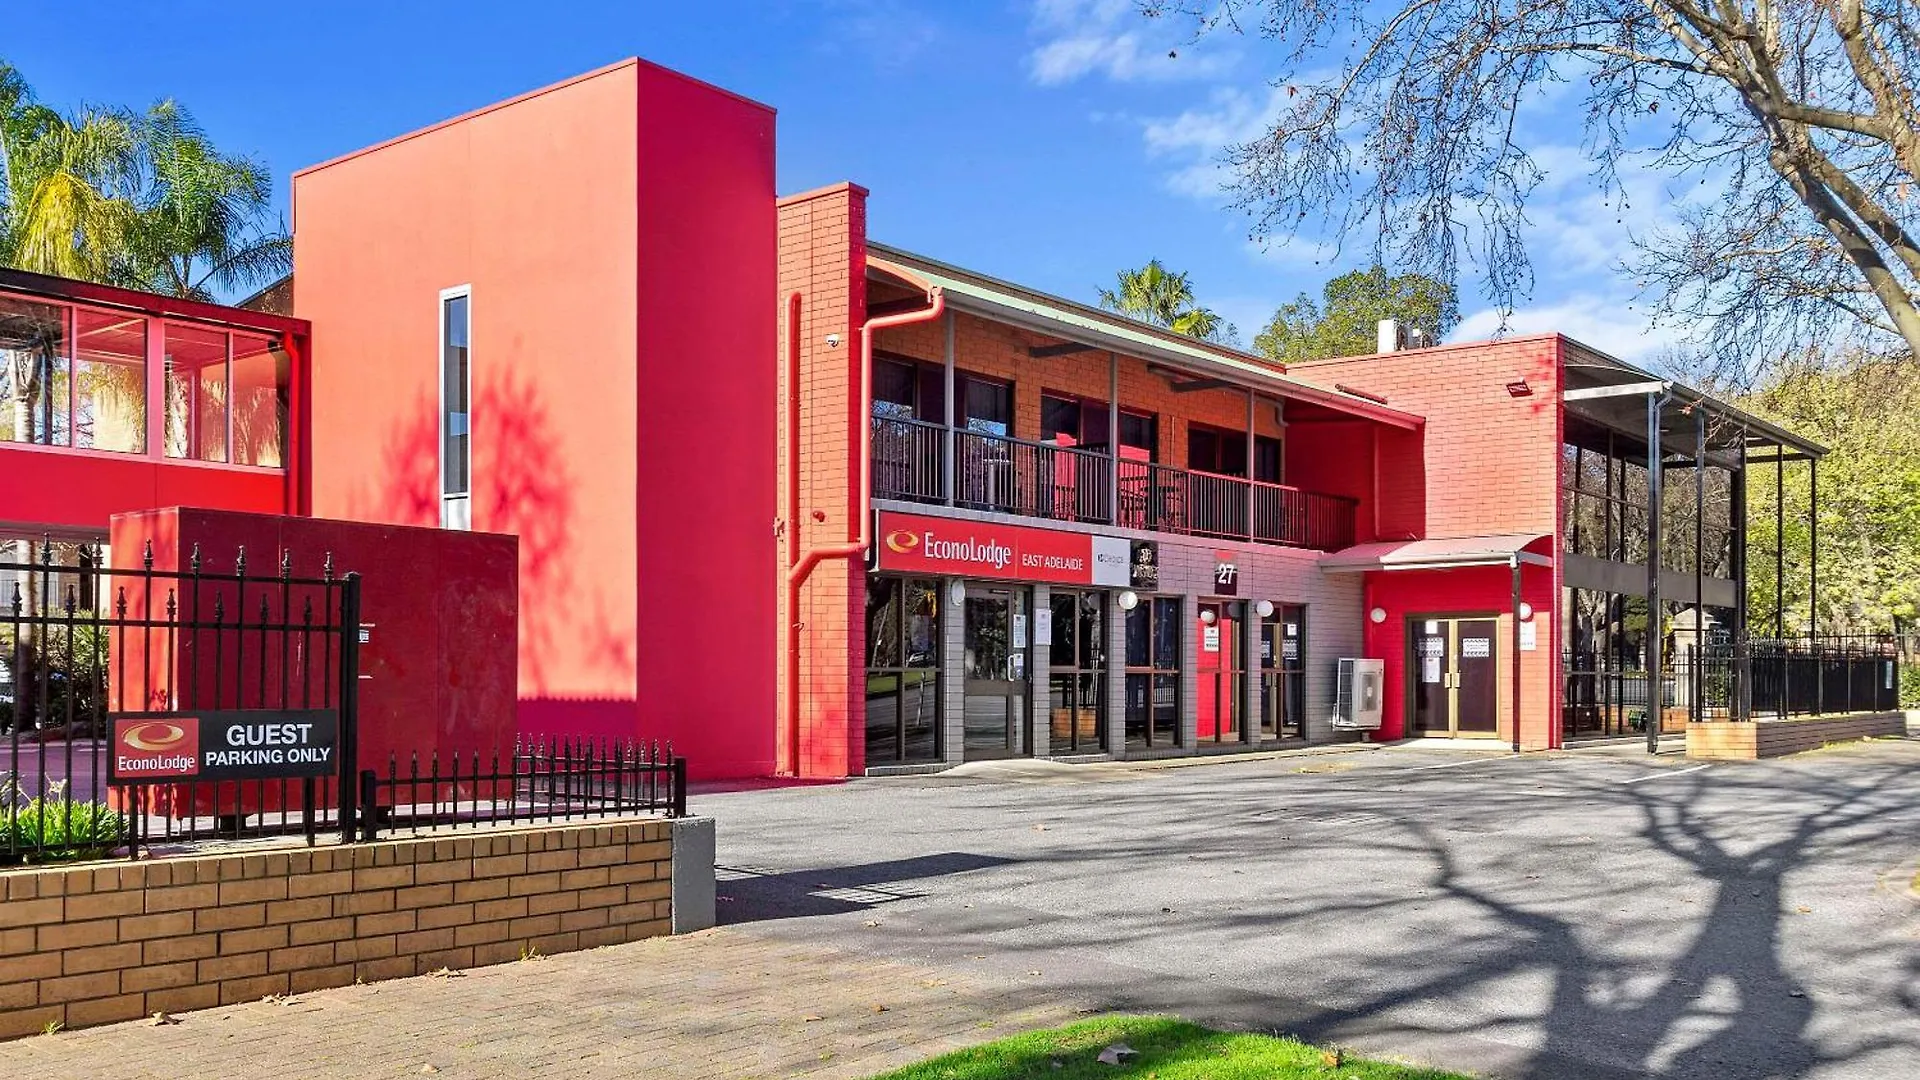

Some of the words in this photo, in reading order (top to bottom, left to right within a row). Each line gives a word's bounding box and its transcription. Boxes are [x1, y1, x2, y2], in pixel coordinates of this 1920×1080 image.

[924, 532, 1011, 568] EconoLodge
[1022, 554, 1043, 567] EAST
[1045, 556, 1083, 571] ADELAIDE
[1218, 563, 1234, 584] 27
[226, 724, 312, 746] GUEST
[118, 755, 196, 772] EconoLodge
[205, 750, 283, 766] PARKING
[287, 748, 330, 763] ONLY
